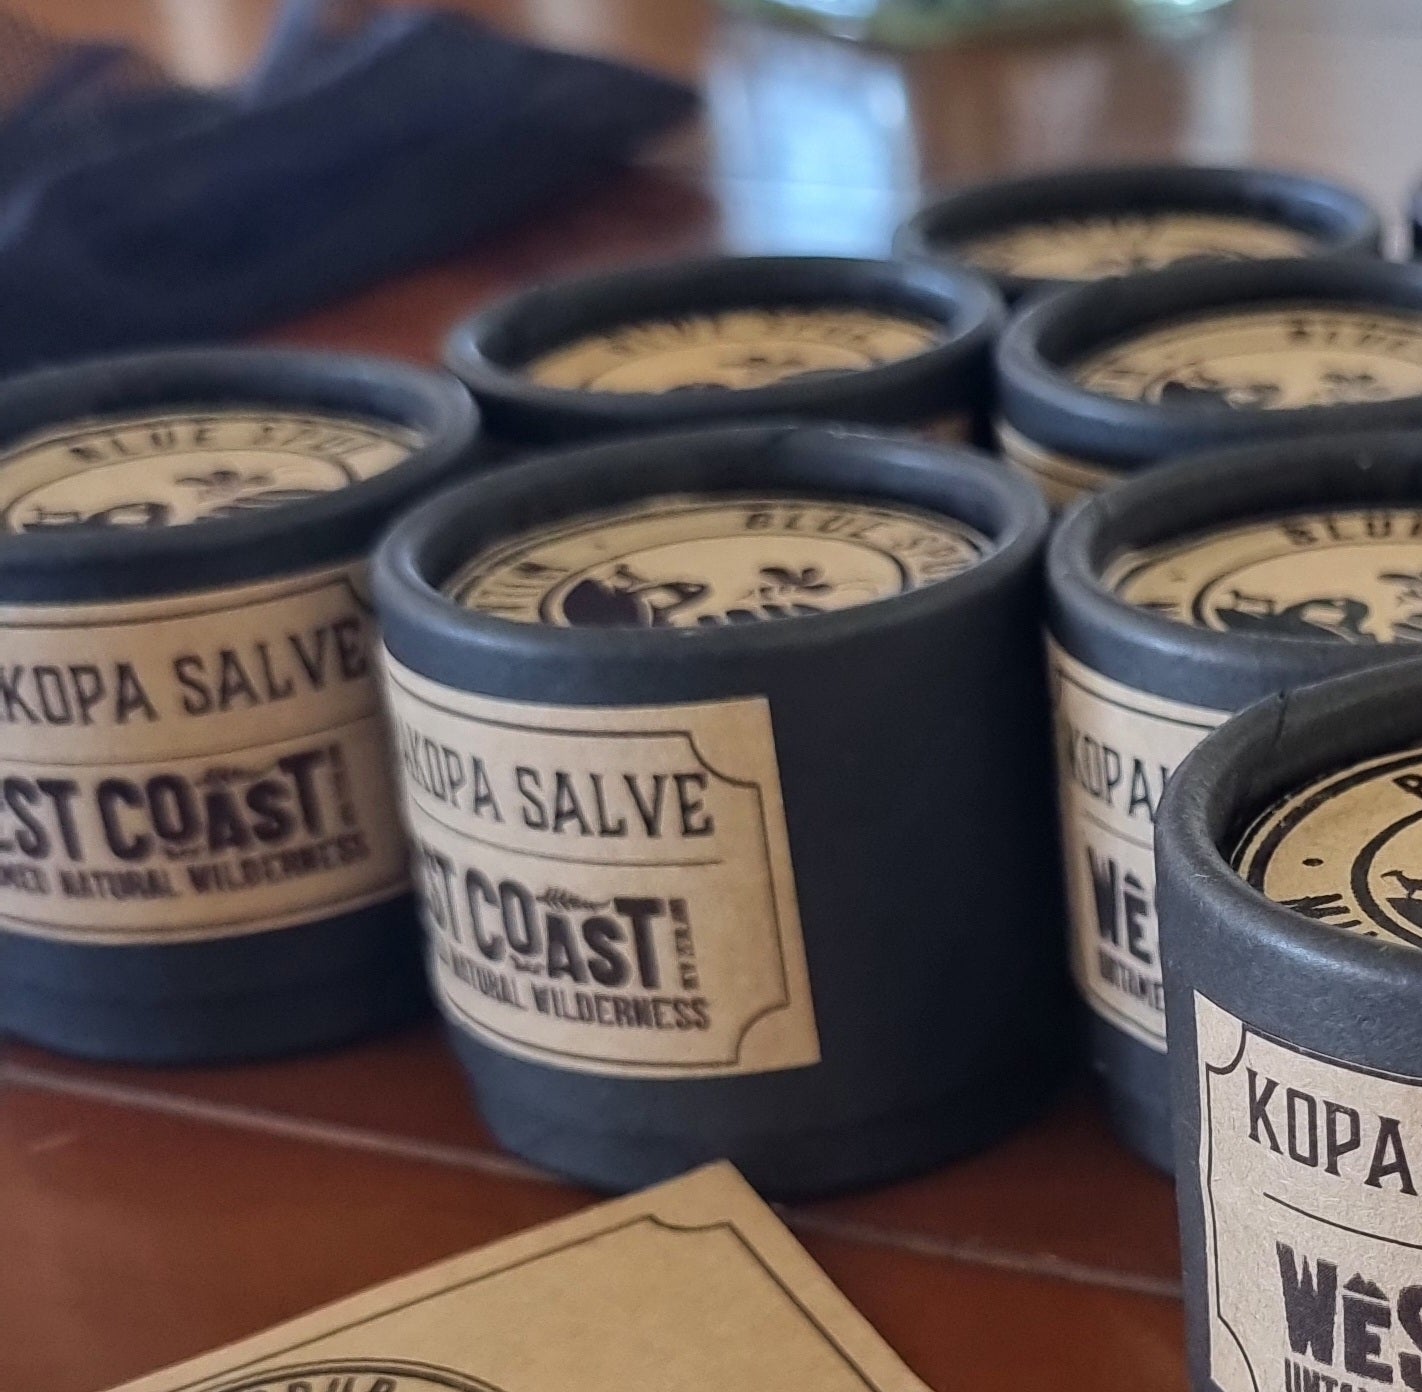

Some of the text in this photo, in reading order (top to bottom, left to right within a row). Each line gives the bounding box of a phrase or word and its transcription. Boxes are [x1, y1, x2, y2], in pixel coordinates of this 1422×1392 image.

[173, 614, 372, 716] SALVE
[0, 773, 84, 862] ST
[96, 747, 330, 863] COAST
[515, 763, 715, 841] SALVE
[464, 868, 666, 993] COAST
[531, 980, 712, 1031] WILDERNESS
